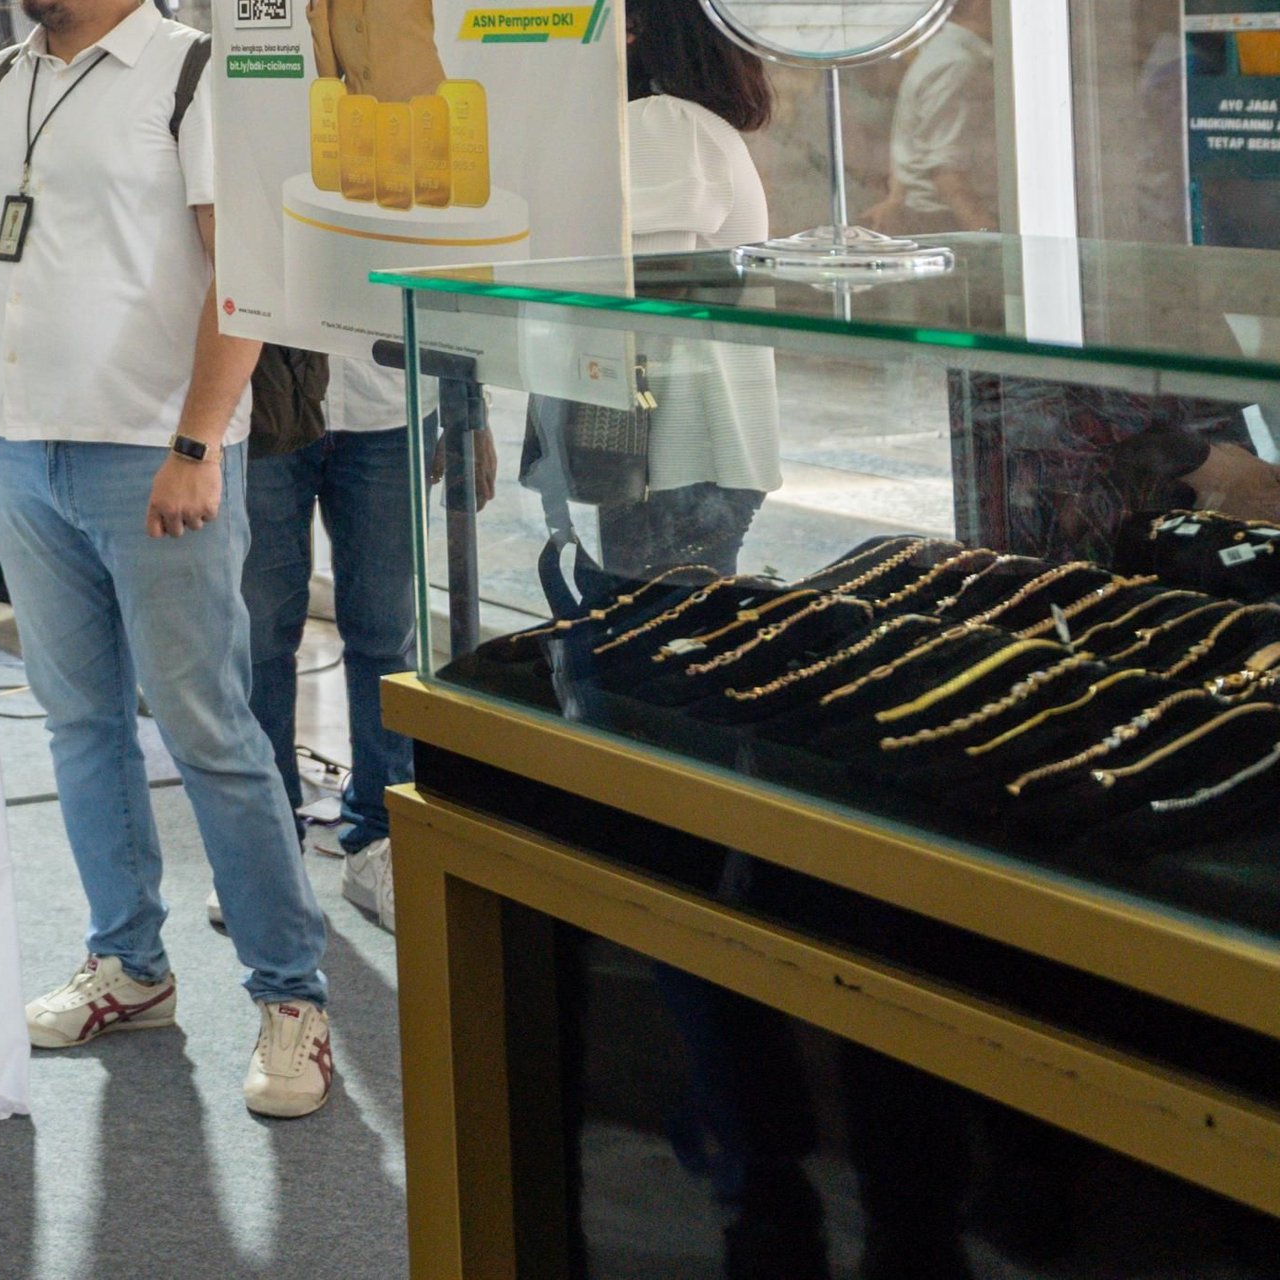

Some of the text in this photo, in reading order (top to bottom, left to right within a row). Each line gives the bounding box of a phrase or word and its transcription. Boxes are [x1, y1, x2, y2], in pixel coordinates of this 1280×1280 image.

[473, 13, 574, 31] ASN Pemprov DKI
[229, 59, 302, 73] bit.ly/bdki-cicilemas
[1220, 99, 1278, 112] AYO JAGA
[1190, 117, 1275, 130] LINGKUNGANMU
[1207, 136, 1245, 150] TETAP
